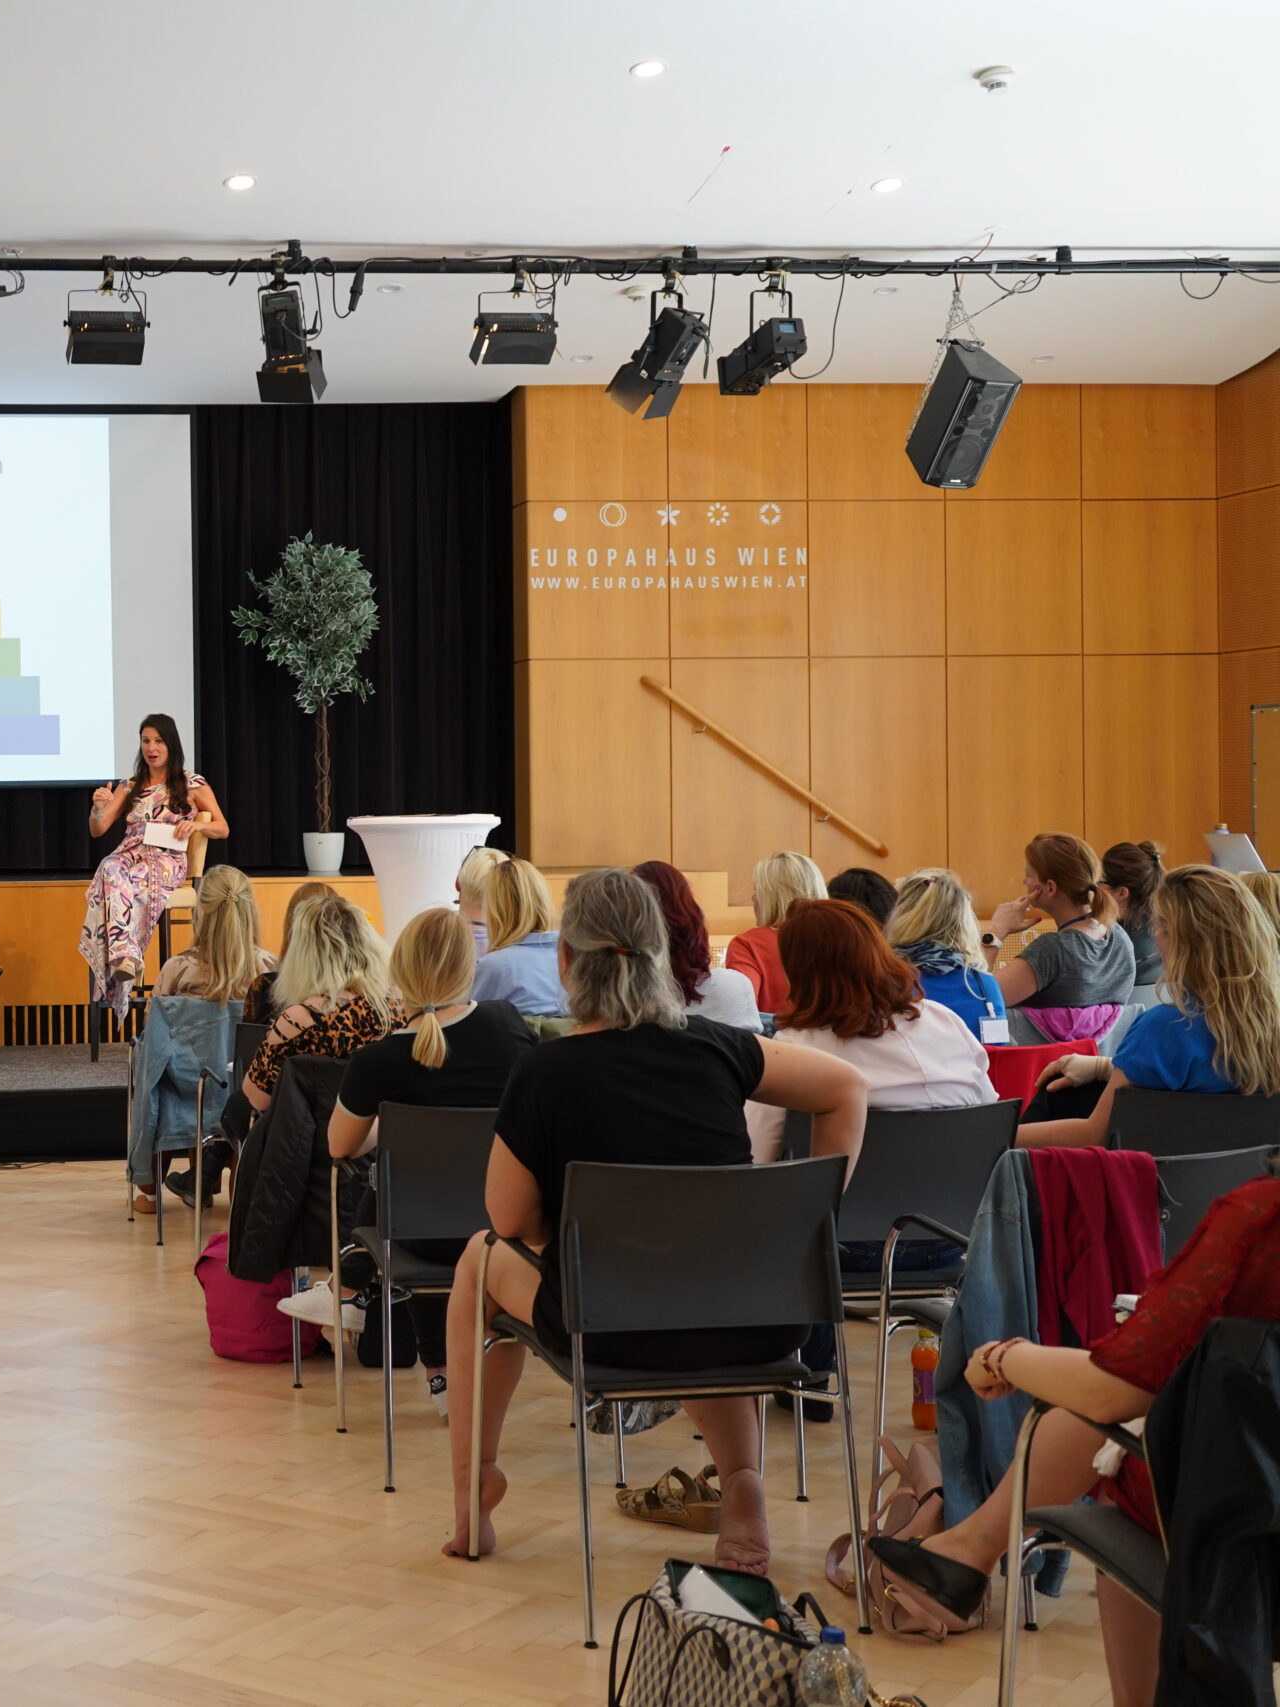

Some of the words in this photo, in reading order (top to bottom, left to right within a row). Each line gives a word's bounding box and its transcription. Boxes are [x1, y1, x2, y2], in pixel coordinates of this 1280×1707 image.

[531, 548, 716, 567] EUROPAHAUS
[738, 547, 807, 566] WIEN
[531, 576, 807, 590] WWW.EUROPAHAUSWIEN.AT
